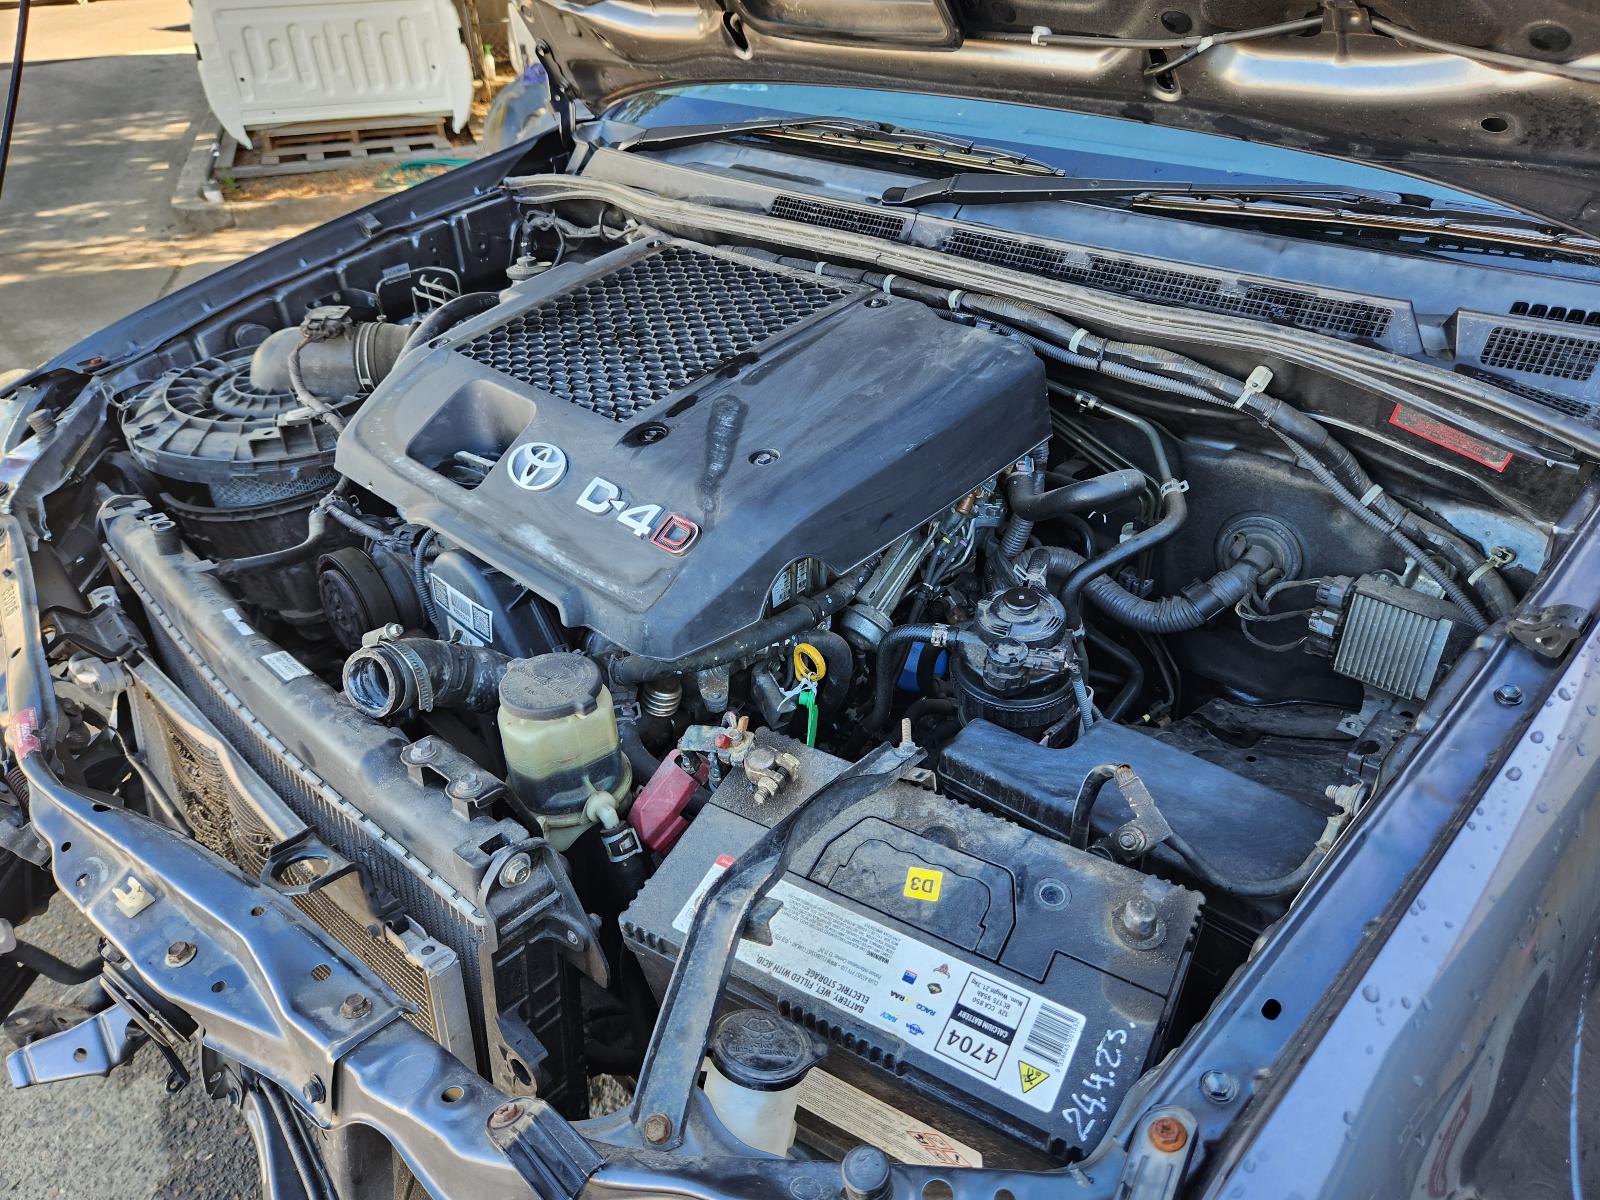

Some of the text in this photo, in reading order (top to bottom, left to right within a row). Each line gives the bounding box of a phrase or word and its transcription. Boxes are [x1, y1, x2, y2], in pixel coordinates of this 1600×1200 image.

[910, 876, 934, 893] D3
[772, 963, 791, 977] WITH
[790, 972, 814, 989] FILLED
[804, 967, 869, 1004] ELECTRIC STORAGE
[813, 983, 832, 997] WET,
[888, 990, 905, 1001] RAA
[989, 986, 1008, 999] Weight
[831, 991, 865, 1013] BATTERY,
[983, 1001, 995, 1011] CCA
[1007, 995, 1023, 1006] Nom.
[915, 1002, 936, 1016] RACQ
[997, 1008, 1008, 1017] 12V
[957, 1008, 1009, 1039] CALCIUM BATTERY
[944, 1028, 999, 1066] 4704
